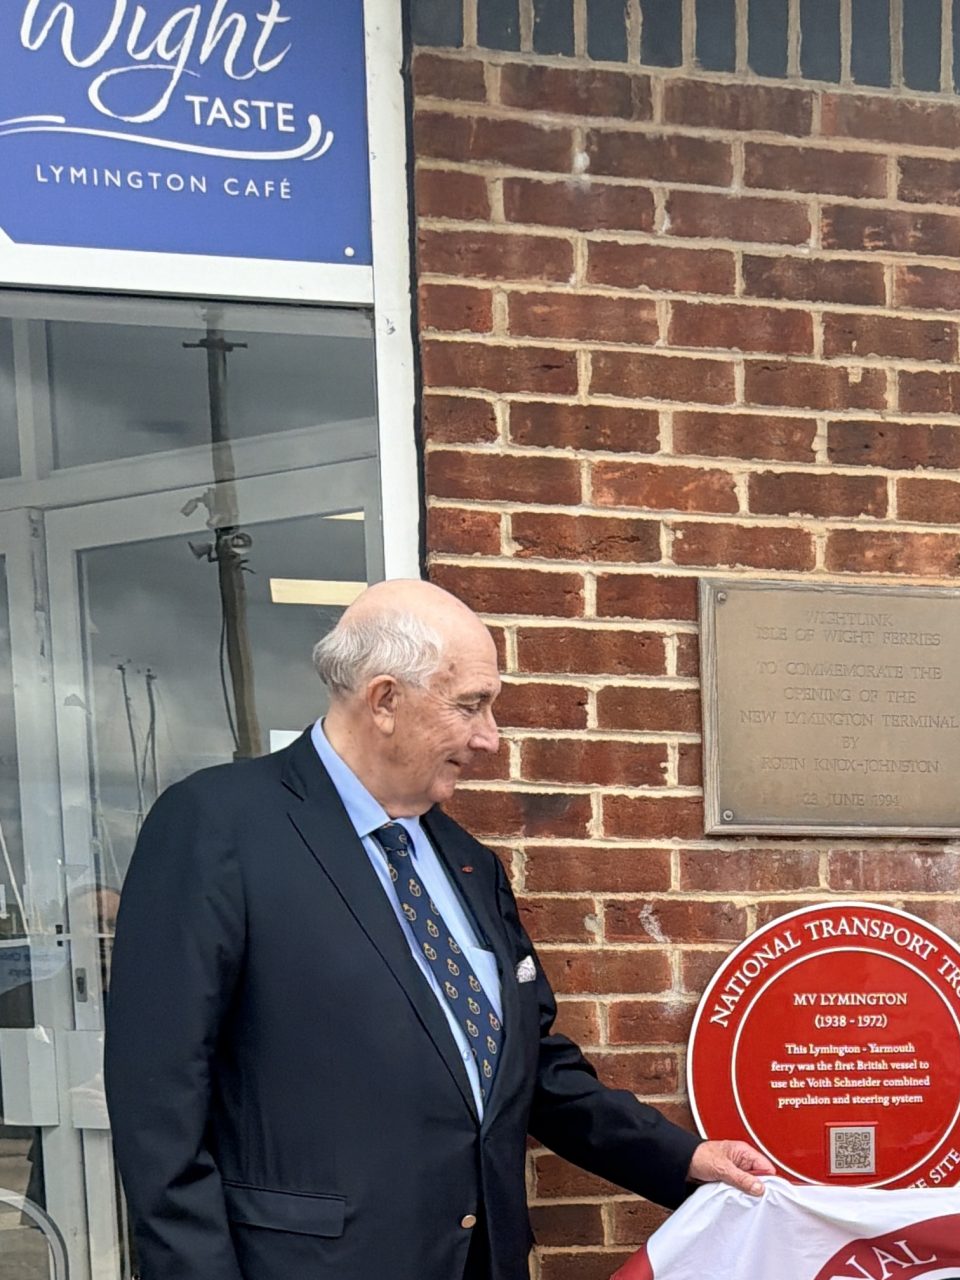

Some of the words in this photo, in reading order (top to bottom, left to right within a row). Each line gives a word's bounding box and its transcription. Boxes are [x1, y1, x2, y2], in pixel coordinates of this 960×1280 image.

[20, 0, 292, 123] Wight
[184, 94, 296, 133] TASTE
[36, 164, 208, 193] LYMINGTON
[223, 177, 292, 200] CAFÉ
[755, 626, 788, 641] ISLE
[794, 628, 815, 642] OF
[823, 629, 875, 644] WIGHT
[882, 631, 942, 647] FERRIES
[757, 661, 778, 675] TO
[785, 661, 904, 679] COMMEMORATE
[911, 666, 943, 680] THE
[783, 686, 851, 702] OPENING
[859, 689, 878, 702] OF
[887, 690, 917, 704] THE
[739, 710, 776, 723] NEW
[785, 711, 874, 727] LYMINGTON
[881, 714, 960, 729] TERMINAL
[841, 736, 860, 749] BY
[814, 757, 940, 775] KNOX-JOHNSTON
[826, 793, 865, 808] JUNE
[709, 930, 802, 1028] NATIONAL
[804, 916, 938, 961] TRANSPORT
[793, 993, 817, 1006] MV
[820, 993, 908, 1006] LYMINGTON
[814, 1013, 847, 1029] (1938
[857, 1013, 888, 1029] 1972)
[785, 1044, 807, 1054] This
[809, 1044, 861, 1057] Lymington
[868, 1042, 916, 1053] Yarmouth
[771, 1061, 795, 1074] ferry
[797, 1063, 815, 1071] was
[817, 1061, 833, 1071] the
[834, 1061, 855, 1071] first
[857, 1060, 888, 1071] British
[890, 1060, 917, 1070] vessel
[919, 1061, 929, 1070] to
[771, 1080, 787, 1089] use
[788, 1078, 805, 1088] the
[806, 1077, 832, 1088] Voith
[834, 1077, 881, 1088] Schneider
[883, 1075, 930, 1087] combined
[778, 1094, 831, 1108] propulsion
[832, 1094, 850, 1105] and
[852, 1094, 889, 1107] steering
[891, 1095, 923, 1107] system
